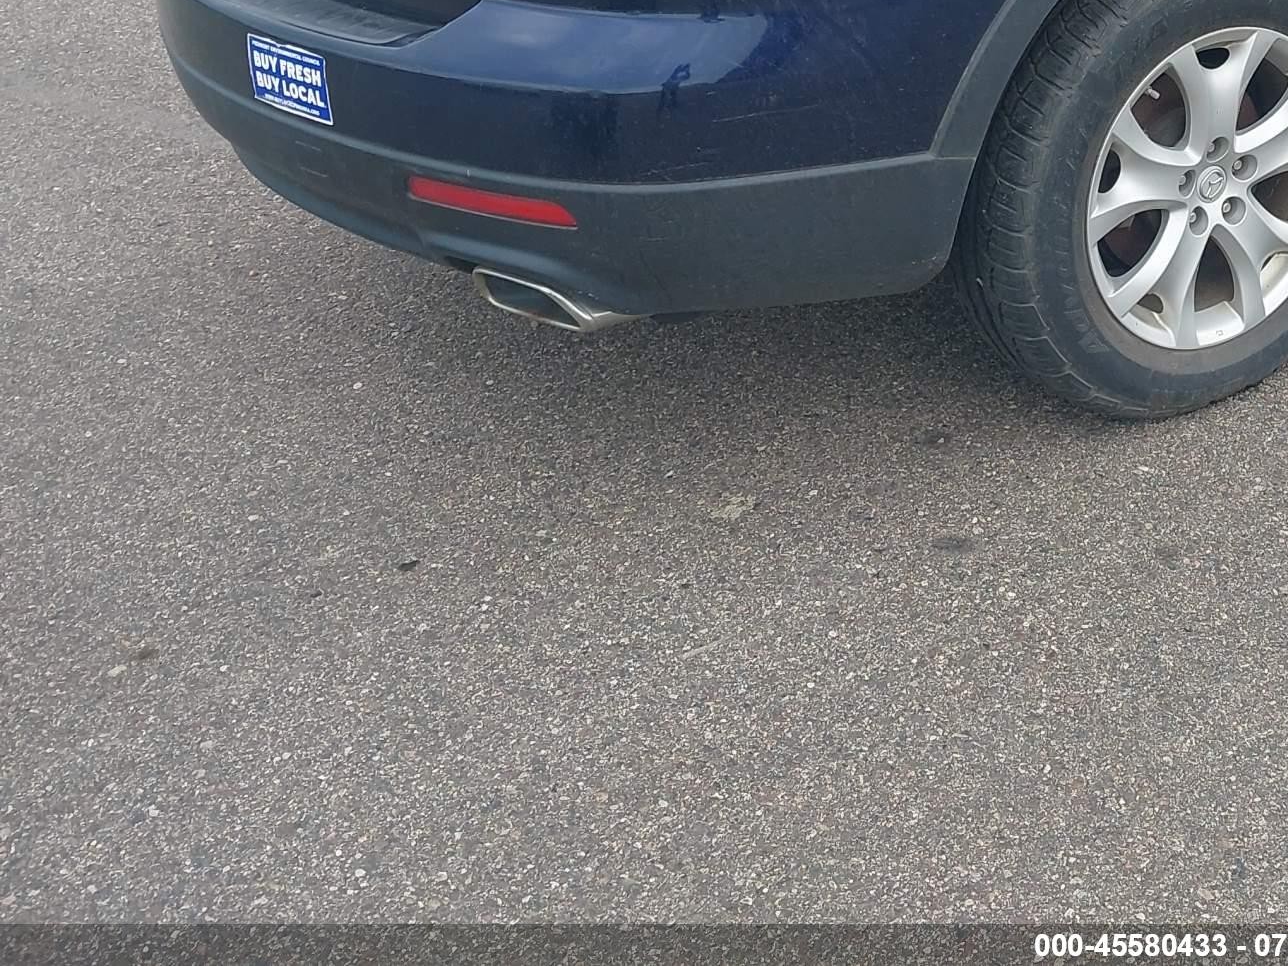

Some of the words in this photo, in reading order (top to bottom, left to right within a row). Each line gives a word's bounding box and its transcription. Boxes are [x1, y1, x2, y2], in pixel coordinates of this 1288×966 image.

[253, 49, 278, 73] BUY
[279, 59, 322, 87] FRESH
[256, 70, 280, 93] BUY
[281, 80, 325, 107] LOCAL
